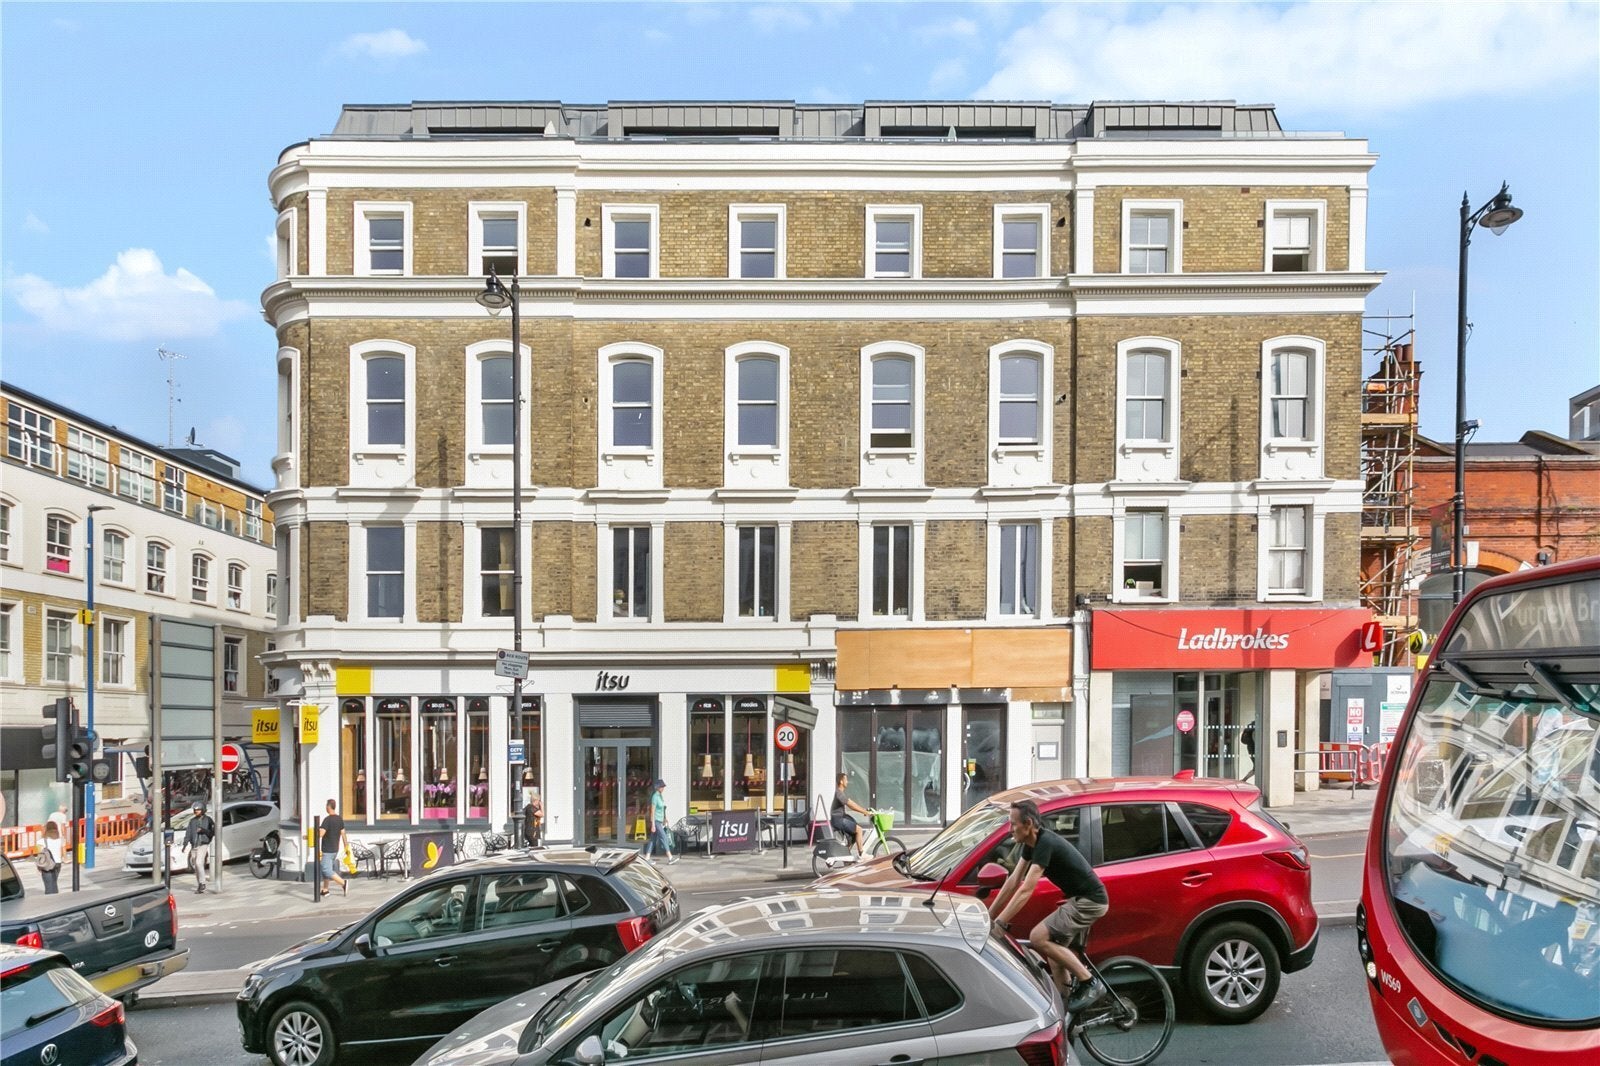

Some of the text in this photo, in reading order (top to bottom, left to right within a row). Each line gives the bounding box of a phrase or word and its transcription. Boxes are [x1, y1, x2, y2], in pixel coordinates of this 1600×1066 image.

[1178, 627, 1290, 650] Ladbrokes
[595, 670, 630, 691] itsu
[1349, 708, 1362, 717] NO
[256, 719, 278, 732] itsu
[304, 717, 318, 731] itsu
[779, 731, 795, 742] 20
[719, 820, 749, 838] itsu
[146, 932, 158, 946] UK
[1380, 969, 1401, 993] WS69
